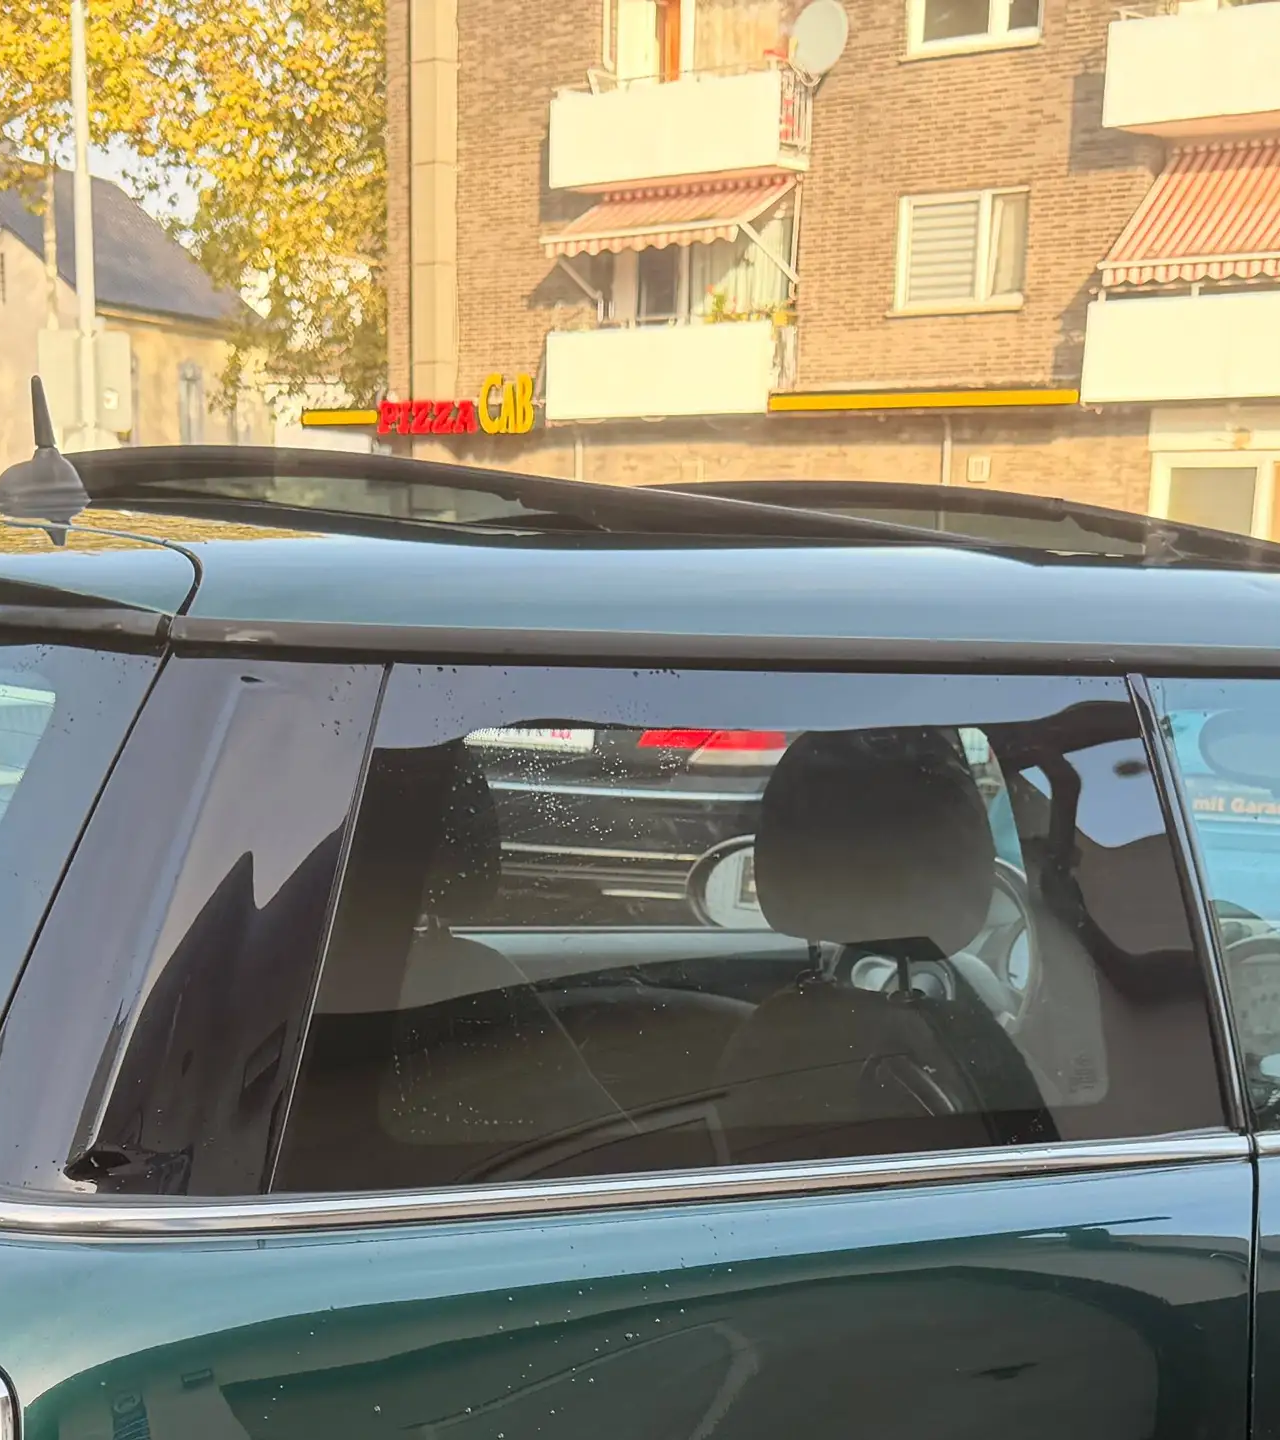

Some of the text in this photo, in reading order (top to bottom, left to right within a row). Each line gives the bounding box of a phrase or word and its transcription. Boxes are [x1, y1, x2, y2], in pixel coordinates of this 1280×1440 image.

[377, 371, 535, 435] PIZZA CAB
[1192, 796, 1226, 813] mit
